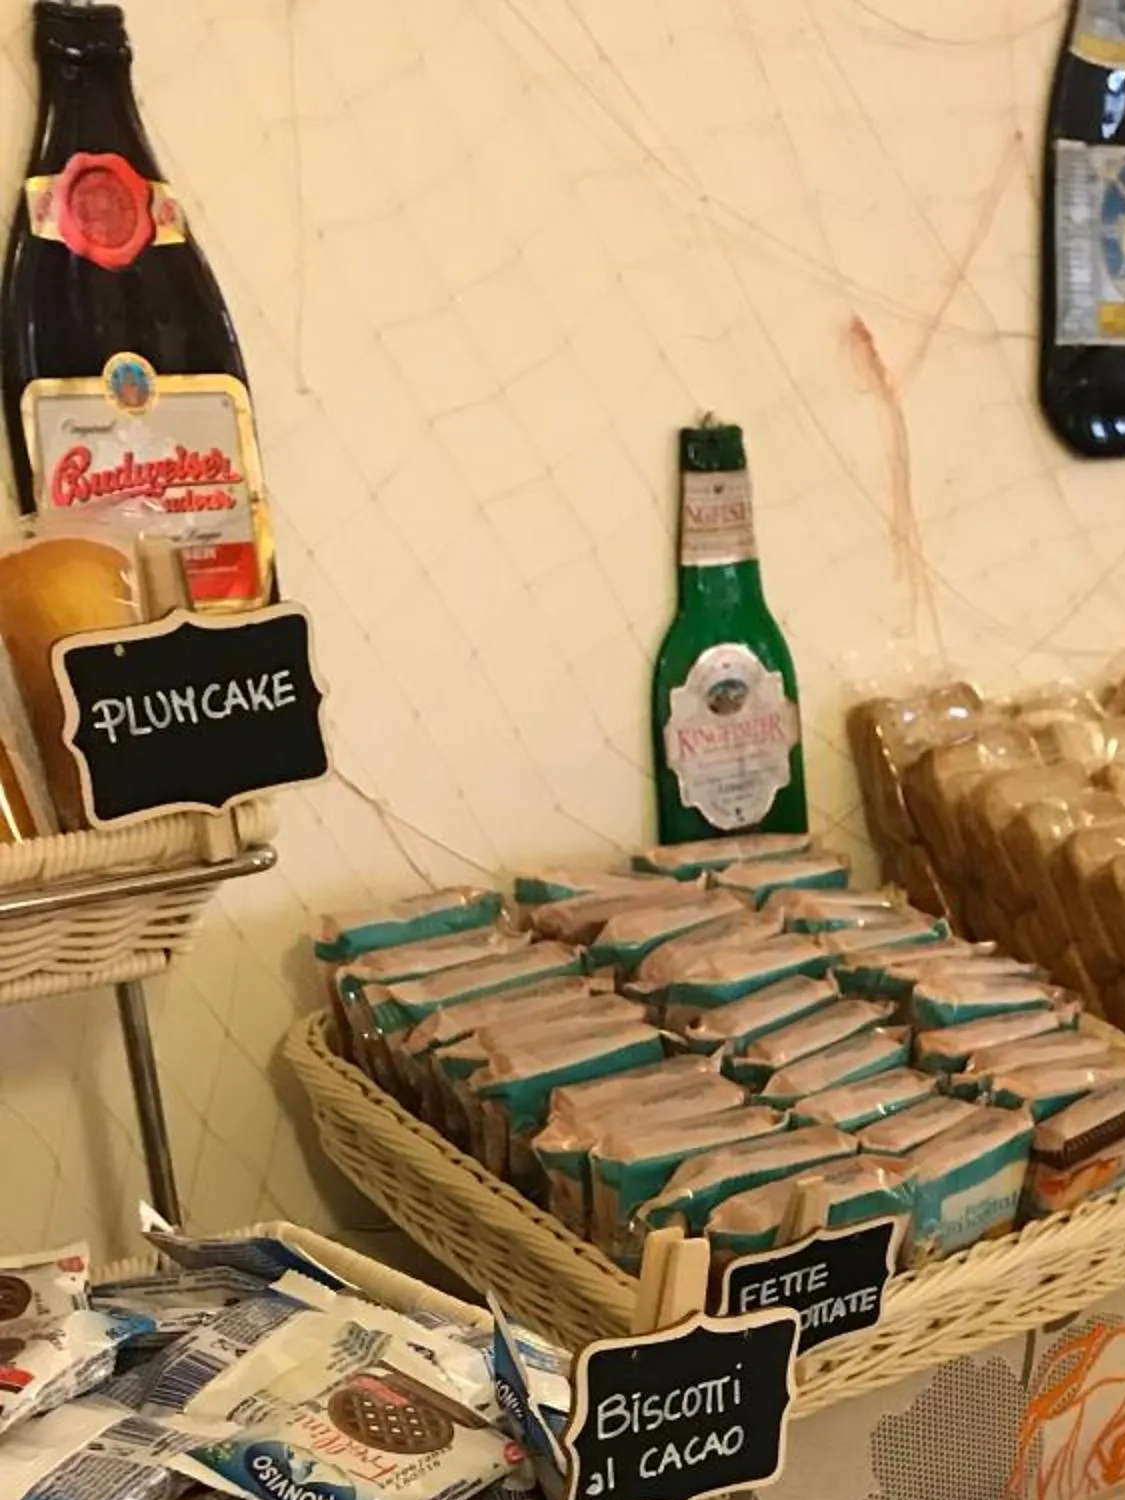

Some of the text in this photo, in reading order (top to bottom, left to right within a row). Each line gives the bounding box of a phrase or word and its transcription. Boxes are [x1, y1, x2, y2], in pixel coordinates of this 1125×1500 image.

[91, 669, 297, 744] PLUMCAKE
[740, 1262, 829, 1314] FETTE
[638, 1425, 745, 1479] CACAO
